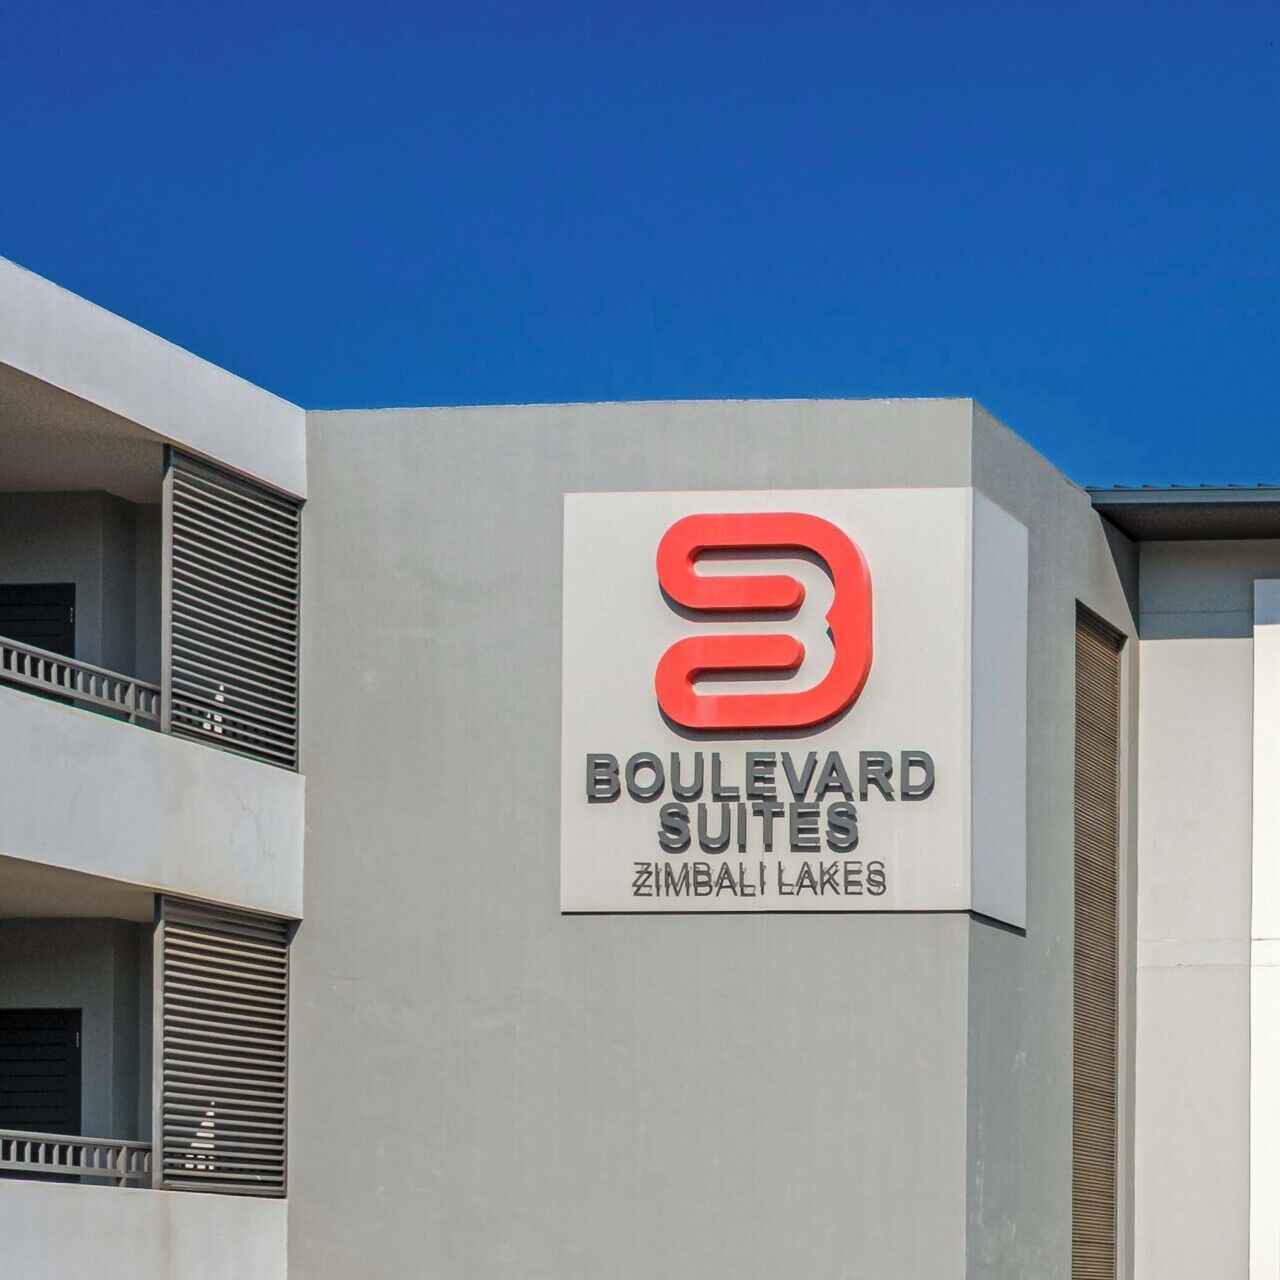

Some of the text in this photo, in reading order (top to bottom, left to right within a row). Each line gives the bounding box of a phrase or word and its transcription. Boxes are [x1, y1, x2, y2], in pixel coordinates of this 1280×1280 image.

[586, 750, 936, 802] BOULEVARD
[658, 802, 860, 852] SUITES
[632, 860, 887, 897] ZIMBALI LAKES
